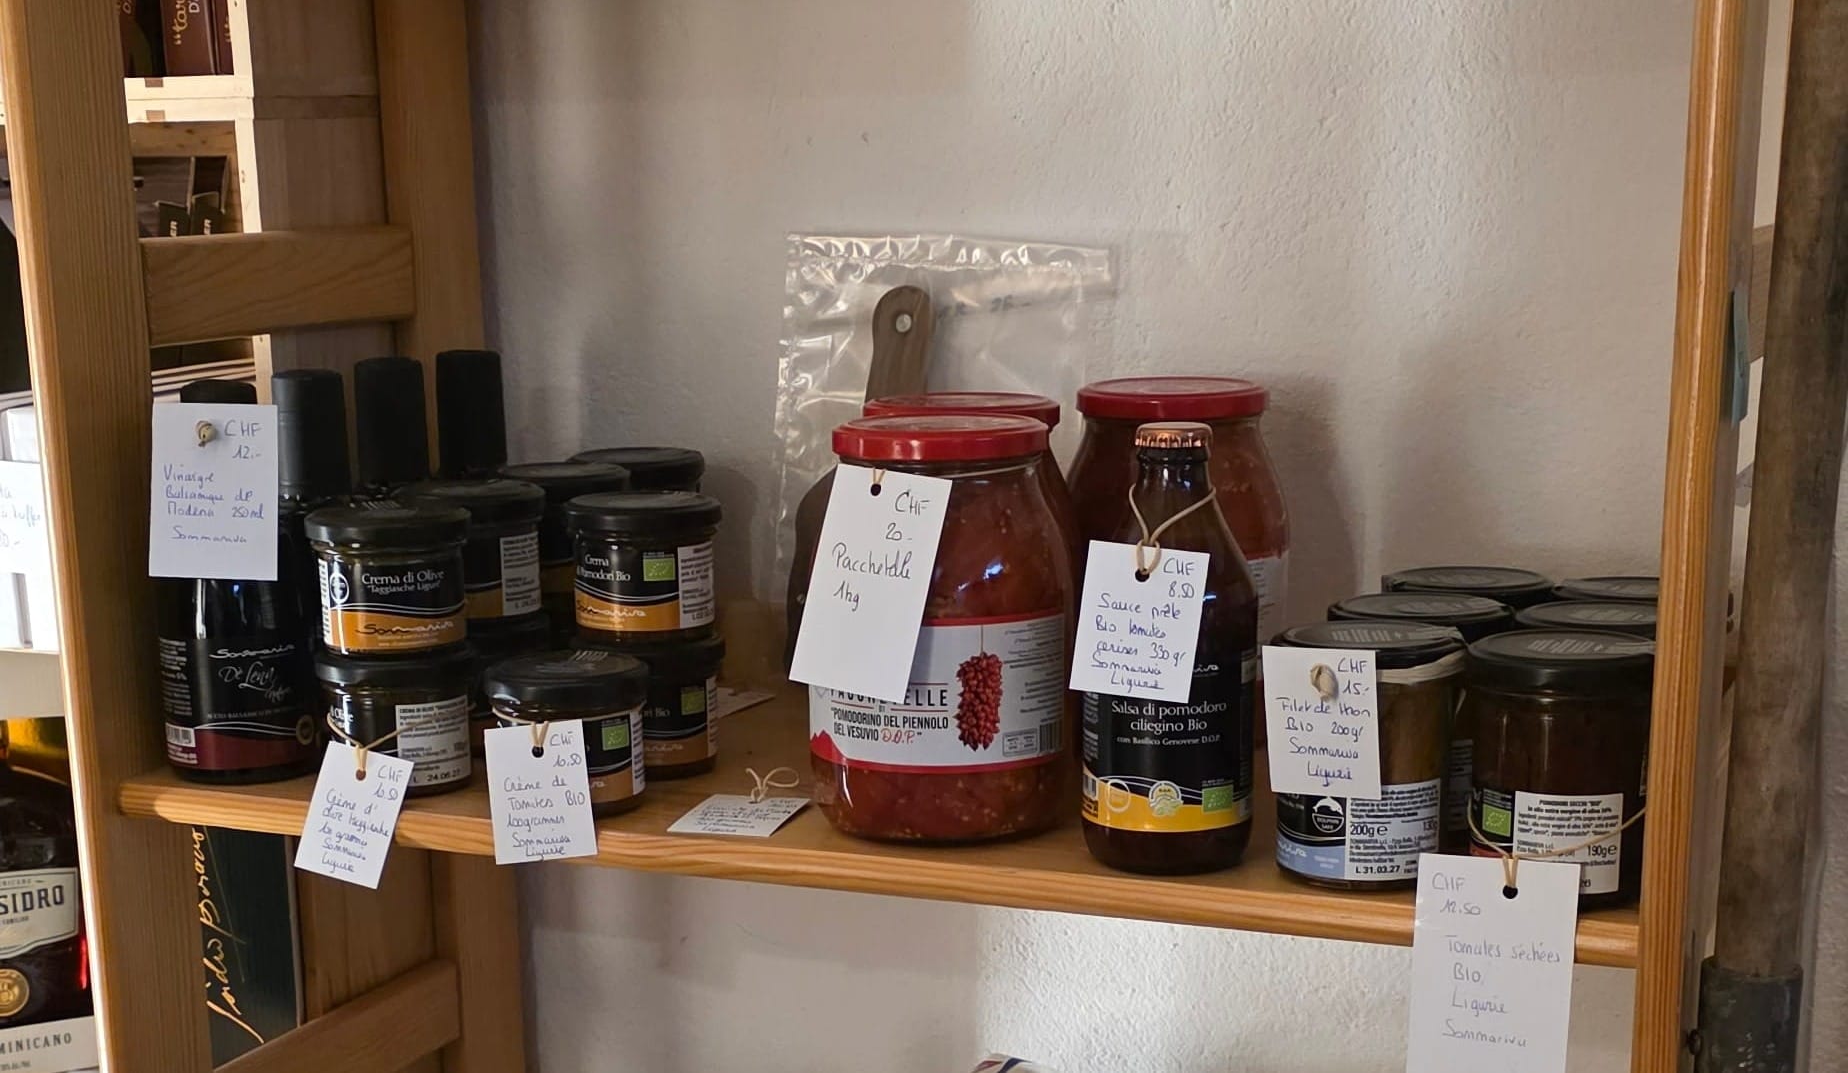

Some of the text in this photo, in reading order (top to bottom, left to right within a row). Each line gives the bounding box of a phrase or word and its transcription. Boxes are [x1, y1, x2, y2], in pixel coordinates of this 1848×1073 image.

[224, 419, 262, 437] CHF
[895, 489, 931, 517] CHF
[1163, 556, 1195, 577] CHF
[361, 573, 400, 585] Crema
[403, 570, 415, 583] di
[615, 570, 631, 582] Bio
[1168, 580, 1195, 599] 8.50
[1097, 592, 1142, 614] Sauce
[1337, 657, 1369, 673] CHF
[1111, 700, 1227, 719] Salsa di pomodoro
[883, 715, 949, 730] DEL PIENNOLO
[1130, 718, 1208, 735] ciliegino Bio
[833, 722, 879, 742] DEL VESUVIO
[1350, 824, 1375, 838] 200g
[1432, 872, 1466, 892] CHF
[0, 884, 65, 916] SIDRO
[1439, 898, 1482, 916] 12.50
